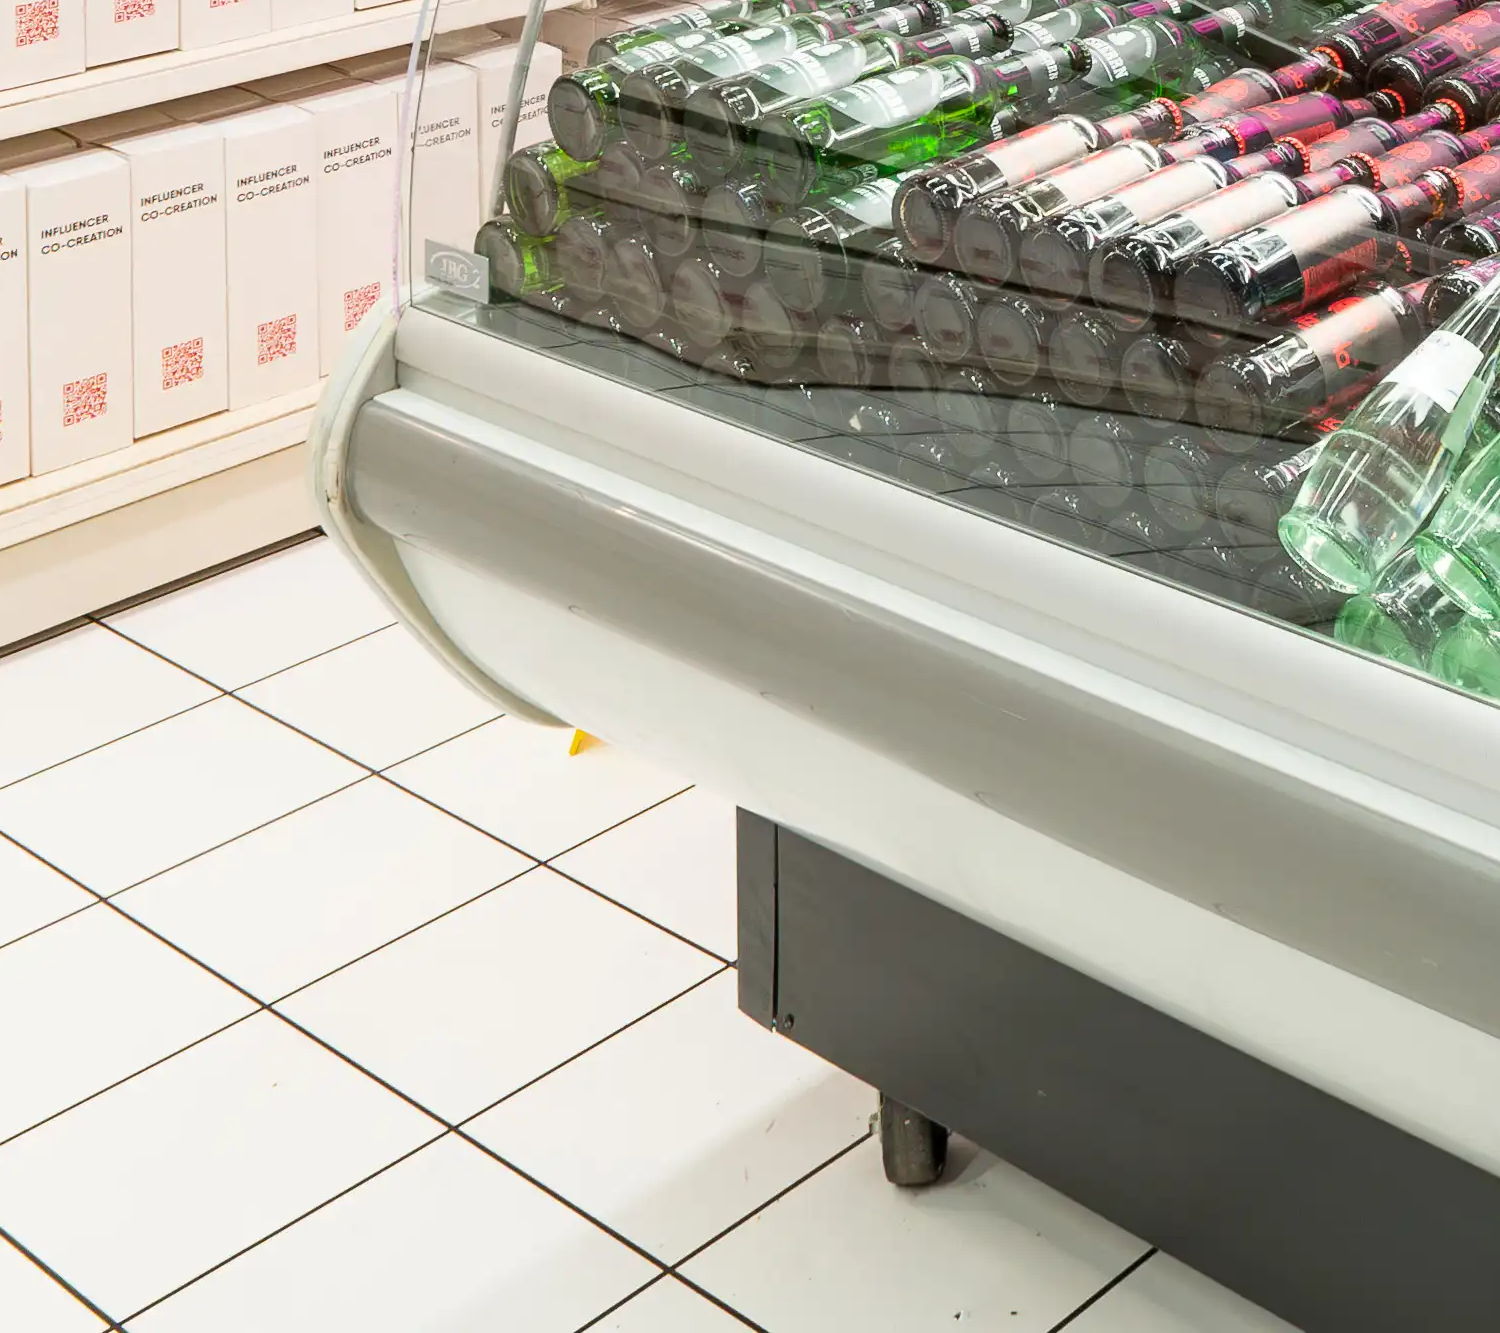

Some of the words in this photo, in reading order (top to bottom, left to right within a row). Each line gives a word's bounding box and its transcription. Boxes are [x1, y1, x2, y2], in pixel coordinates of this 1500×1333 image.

[236, 164, 297, 189] INFLUENCER
[236, 175, 310, 203] CO-CREATION
[40, 213, 109, 240] INFLUENCER
[40, 225, 123, 255] CO-CREATION
